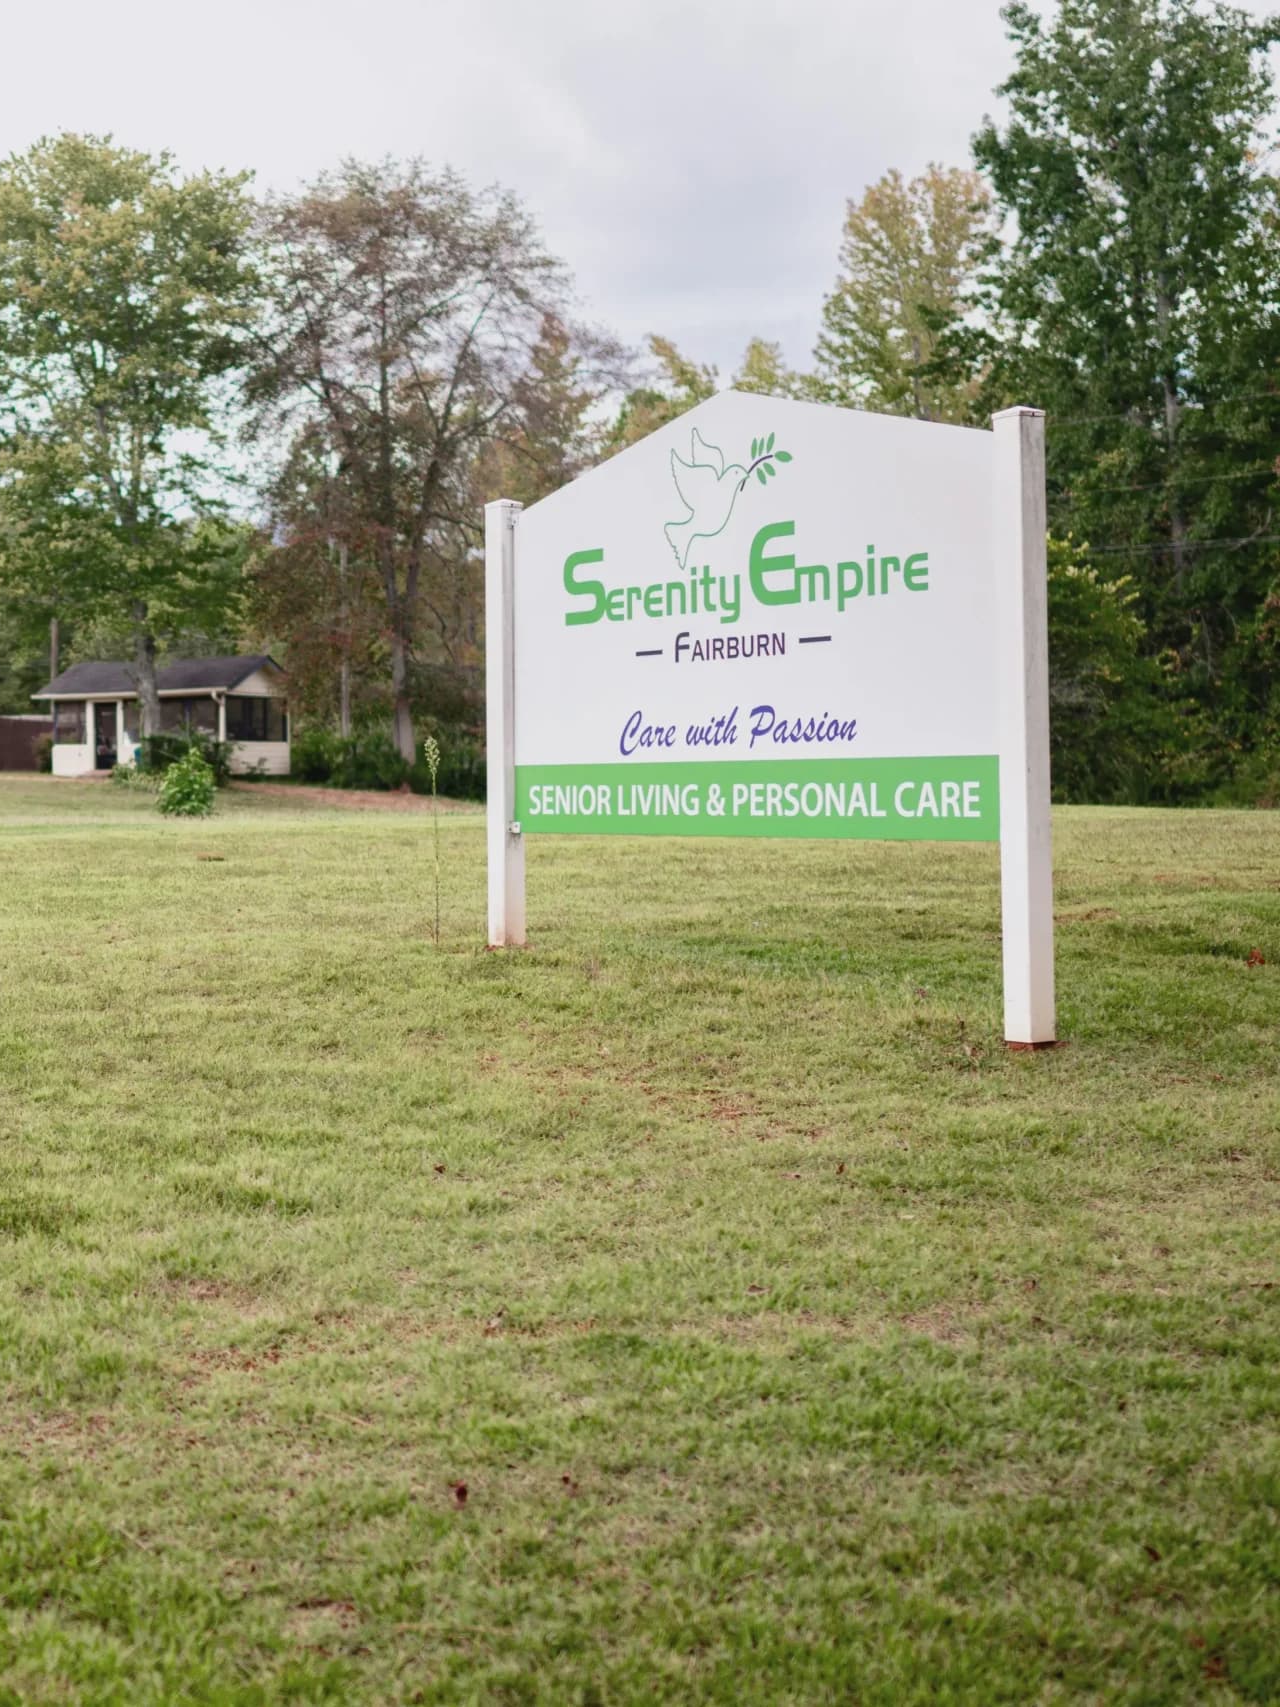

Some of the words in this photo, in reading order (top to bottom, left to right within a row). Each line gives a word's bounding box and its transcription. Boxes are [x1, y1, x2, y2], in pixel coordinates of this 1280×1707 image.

[563, 548, 740, 626] Serenity
[749, 521, 928, 612] Empire
[619, 710, 676, 756] Care
[686, 706, 739, 747] with
[749, 705, 857, 748] Passion
[529, 785, 611, 815] SENIOR
[618, 784, 699, 815] LIVING
[707, 784, 725, 816] &
[733, 783, 886, 816] PERSONAL
[895, 782, 980, 817] CARE
